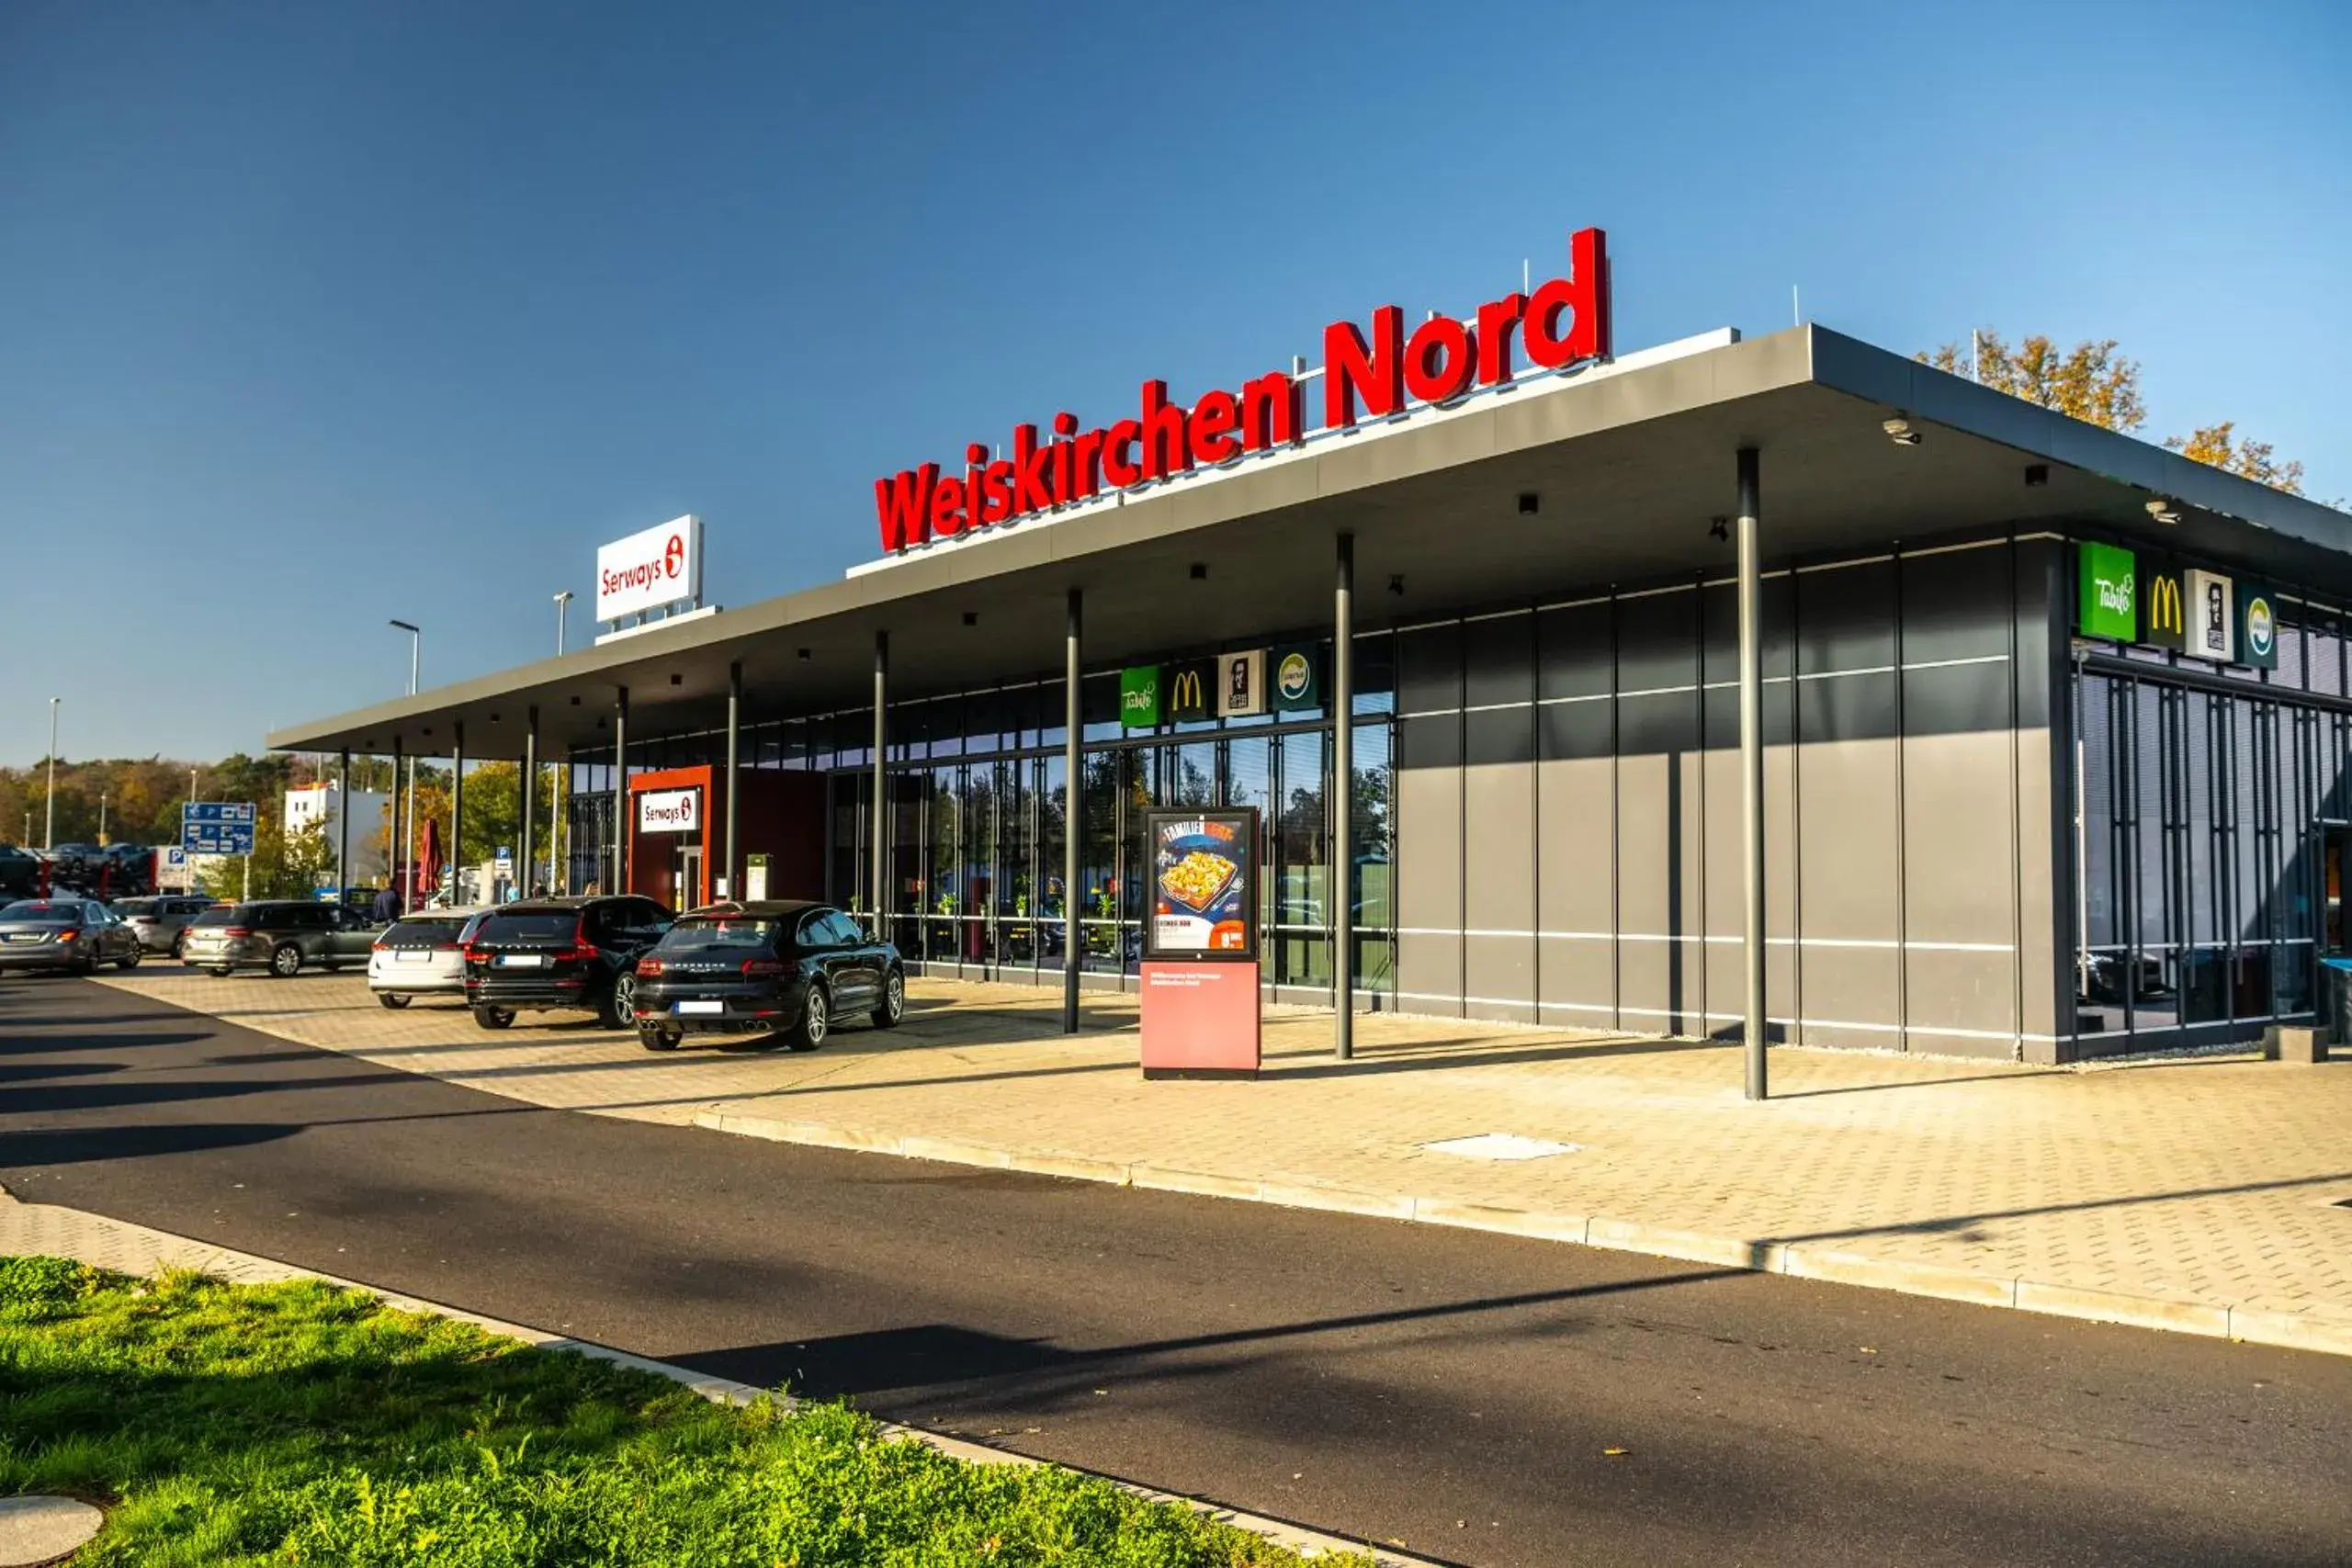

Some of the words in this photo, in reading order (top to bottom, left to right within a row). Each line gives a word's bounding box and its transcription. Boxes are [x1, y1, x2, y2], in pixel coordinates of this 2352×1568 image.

[875, 370, 1301, 552] Weiskirchen
[1323, 226, 1606, 429] Nord
[602, 558, 662, 596] Serways
[645, 805, 680, 824] Serways
[172, 851, 181, 863] P
[499, 849, 507, 859] P
